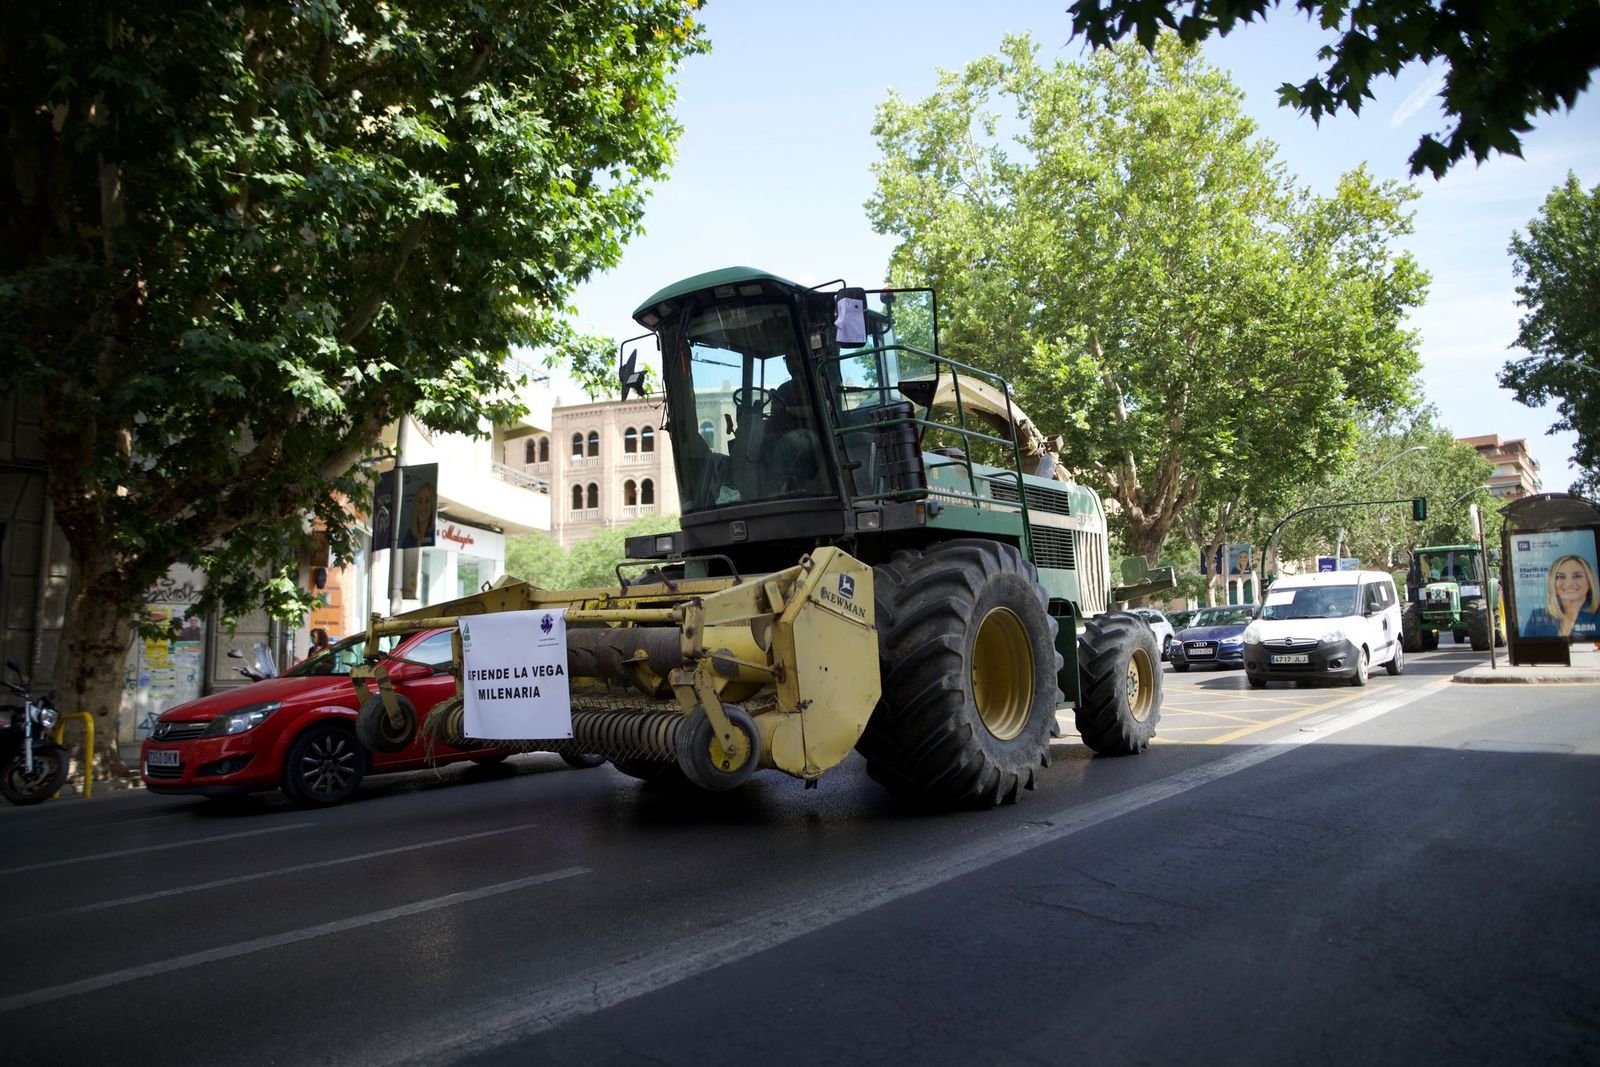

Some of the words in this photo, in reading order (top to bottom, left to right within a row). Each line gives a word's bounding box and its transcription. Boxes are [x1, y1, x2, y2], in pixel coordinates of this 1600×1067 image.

[1274, 655, 1291, 663] 4717
[514, 667, 528, 679] LA
[532, 664, 564, 677] VEGA
[478, 686, 541, 701] MILENARIA
